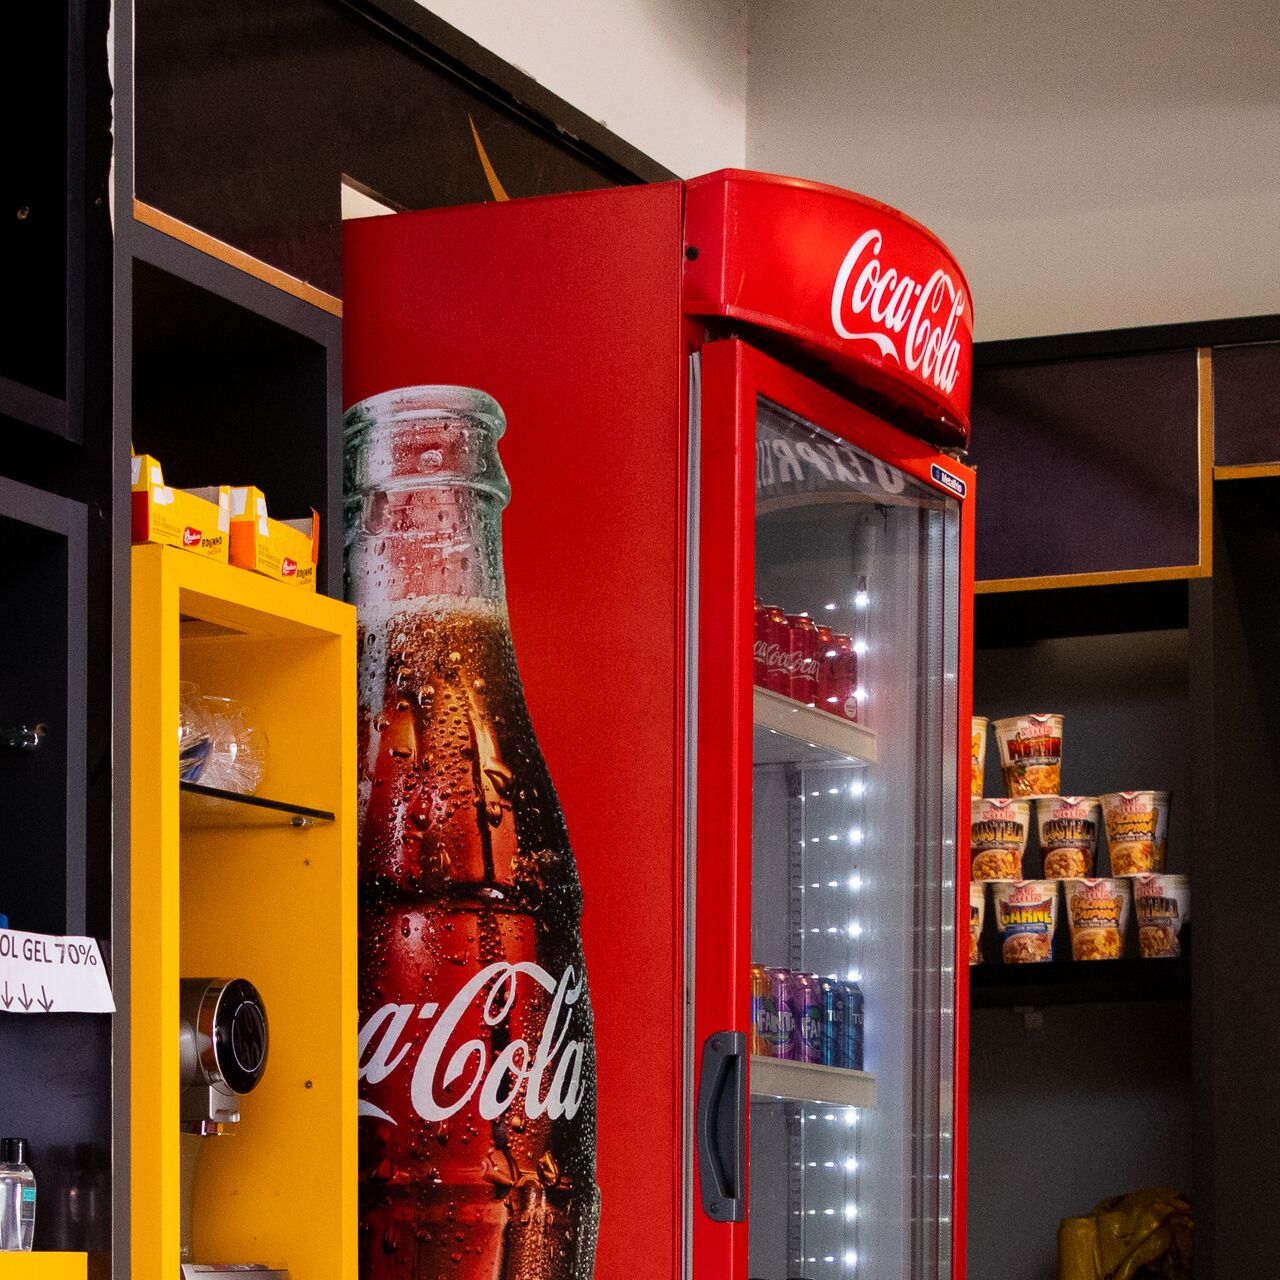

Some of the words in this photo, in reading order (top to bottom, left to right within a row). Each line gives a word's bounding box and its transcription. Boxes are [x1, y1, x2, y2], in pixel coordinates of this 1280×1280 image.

[832, 229, 963, 393] Coca-Cola
[23, 938, 53, 964] GEL
[55, 943, 97, 966] 70%
[358, 961, 588, 1122] a-Cola
